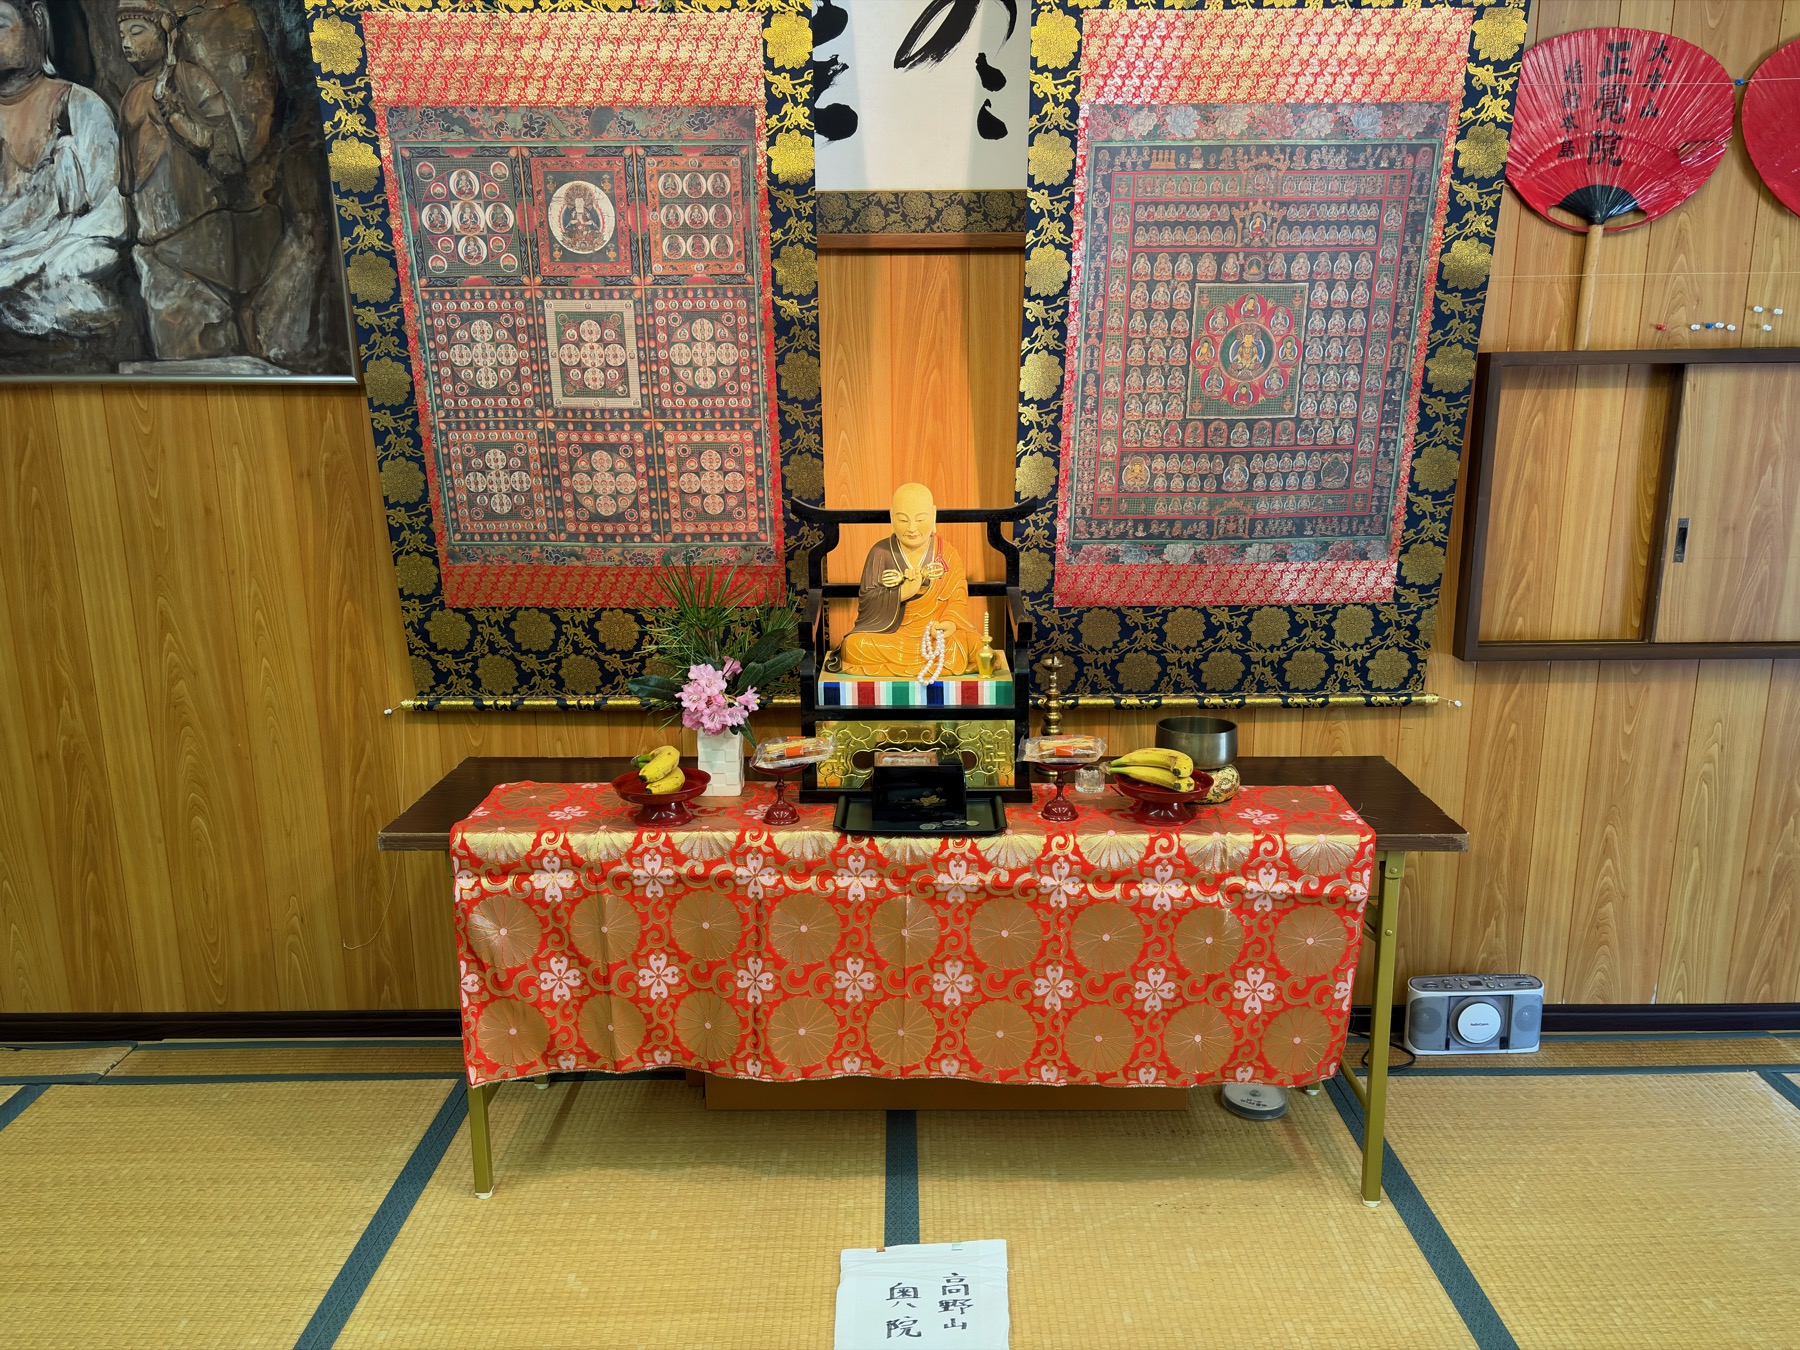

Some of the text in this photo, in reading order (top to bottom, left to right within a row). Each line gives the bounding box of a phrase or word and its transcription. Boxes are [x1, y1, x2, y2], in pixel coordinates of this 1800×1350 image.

[885, 1282, 922, 1339] 奥院
[938, 1272, 974, 1330] 高野山
